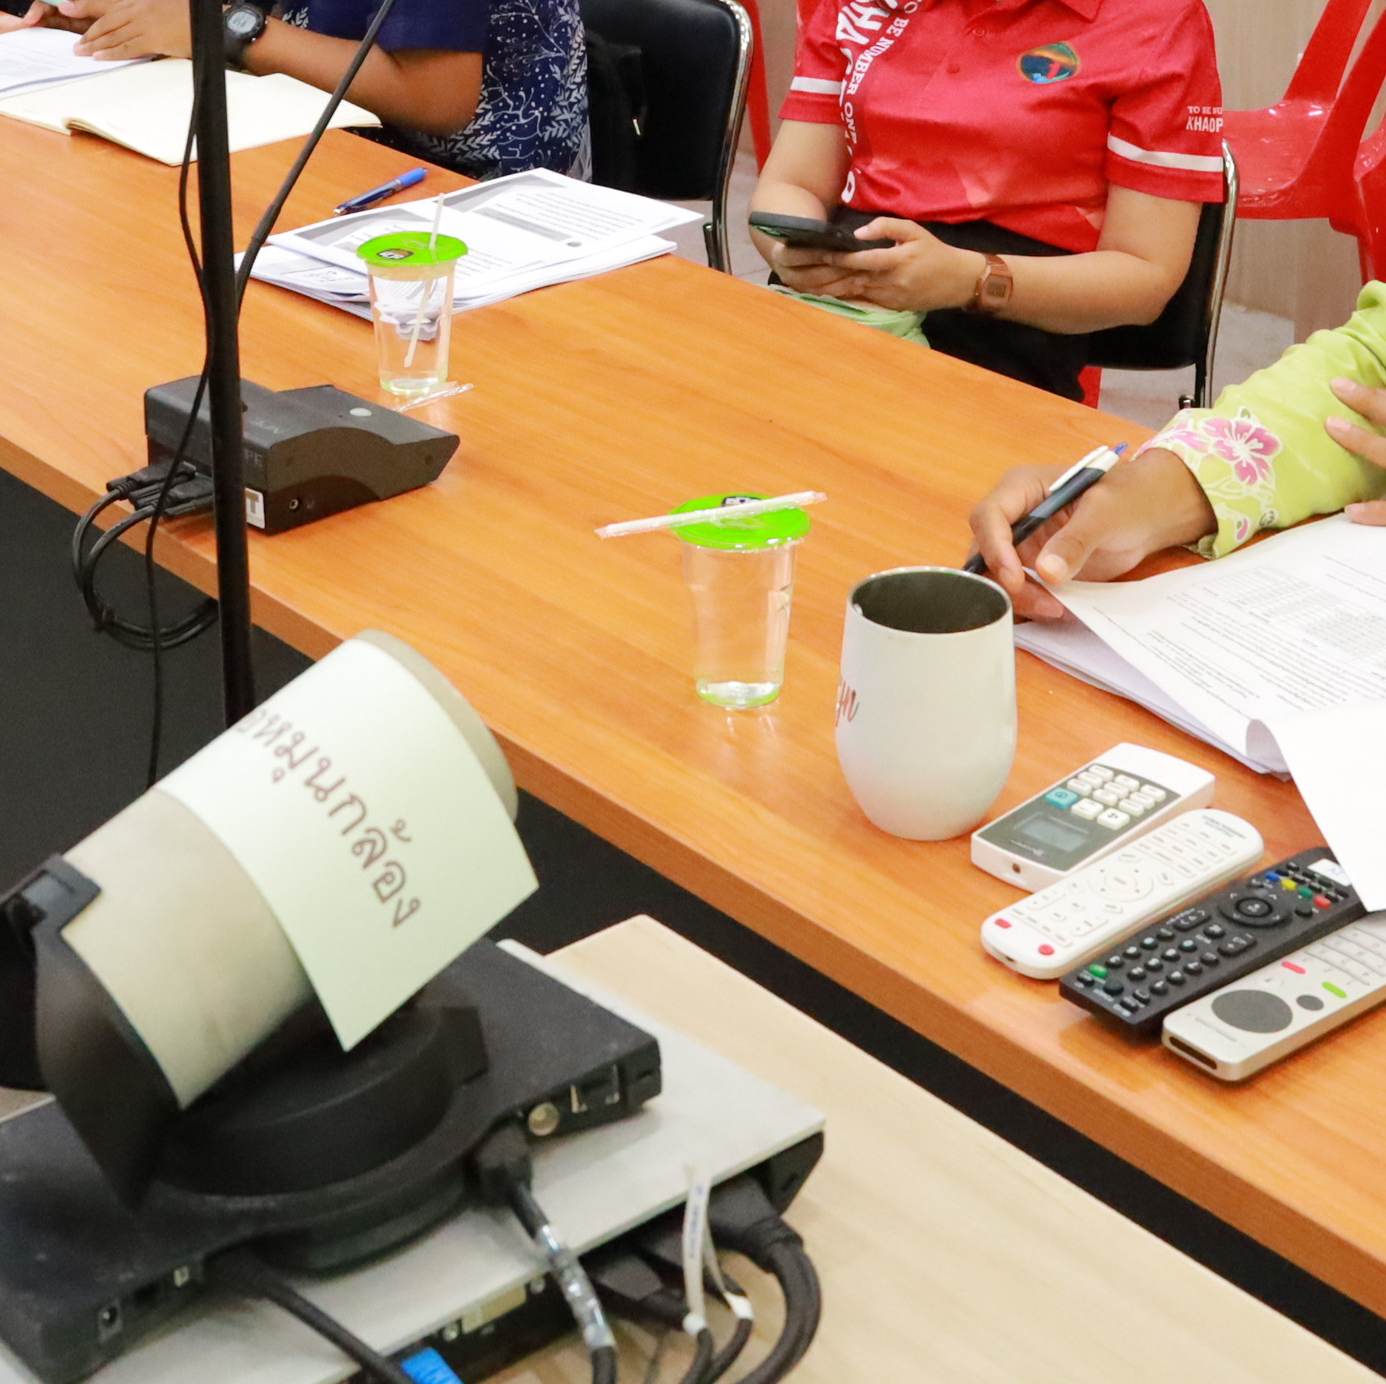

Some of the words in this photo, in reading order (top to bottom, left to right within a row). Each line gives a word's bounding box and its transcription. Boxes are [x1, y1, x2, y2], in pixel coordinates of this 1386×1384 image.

[885, 17, 910, 37] BE
[846, 36, 895, 95] NUMBER
[1187, 105, 1201, 115] TO
